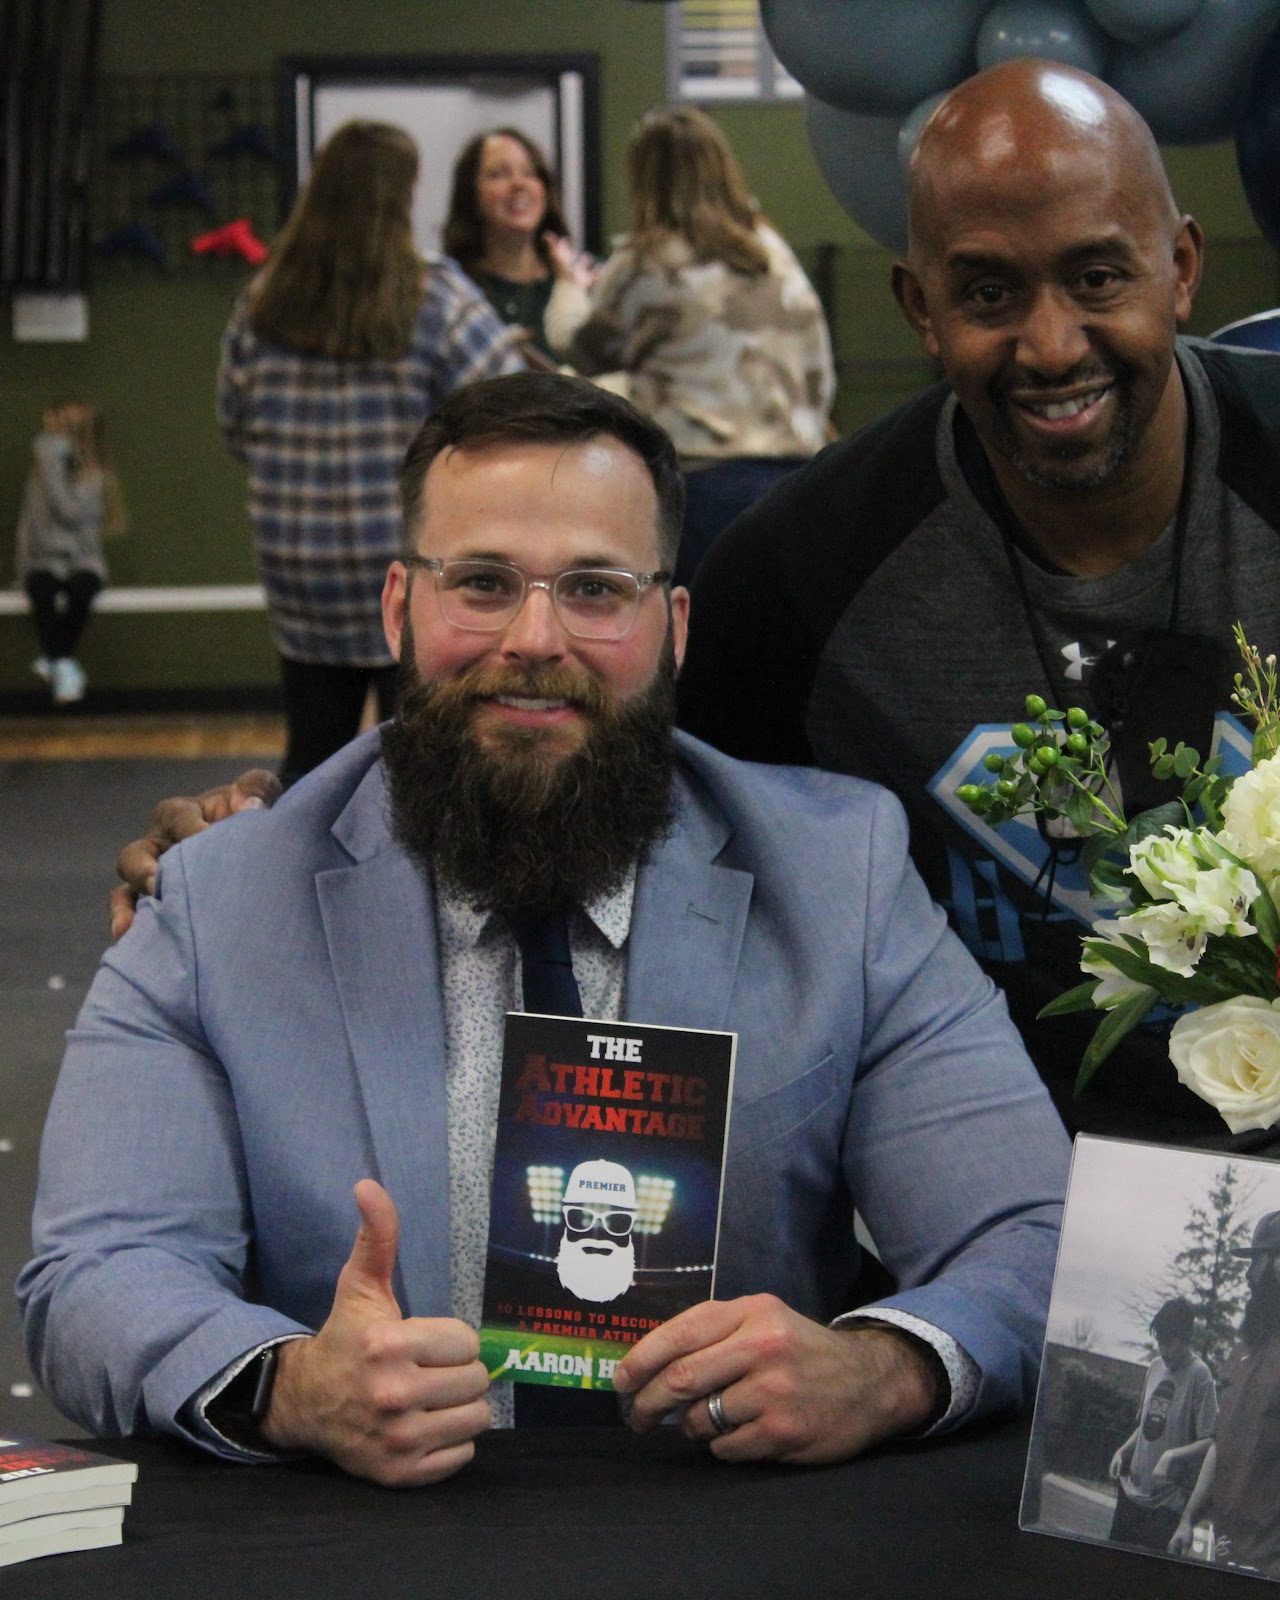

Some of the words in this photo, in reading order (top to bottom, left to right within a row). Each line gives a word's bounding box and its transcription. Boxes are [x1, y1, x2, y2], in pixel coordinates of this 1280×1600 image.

[586, 1035, 643, 1063] THE
[515, 1053, 708, 1105] ATHLETIC
[512, 1092, 705, 1140] ADVANTAGE
[579, 1179, 626, 1192] PREMIER
[518, 1305, 582, 1322] LESSONS
[588, 1312, 606, 1325] TO
[611, 1315, 666, 1329] BECOM
[533, 1321, 597, 1340] PREMIER
[603, 1329, 645, 1344] ATHL
[504, 1349, 592, 1377] AARON
[598, 1358, 620, 1378] H
